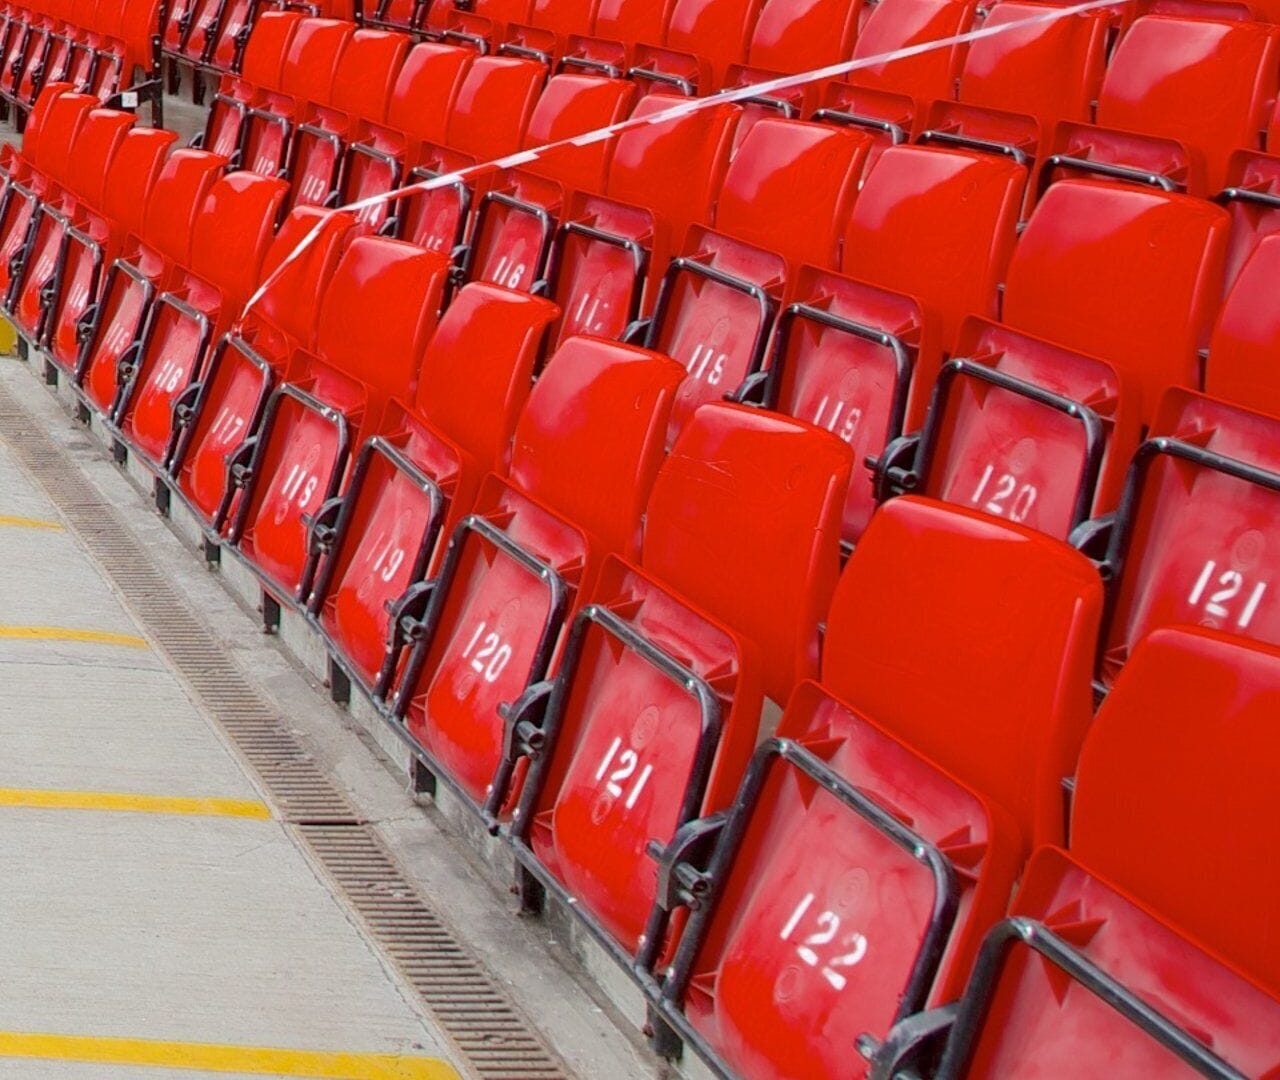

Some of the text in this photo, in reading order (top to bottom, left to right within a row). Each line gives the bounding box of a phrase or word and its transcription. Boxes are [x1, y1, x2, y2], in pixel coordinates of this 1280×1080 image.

[302, 174, 327, 202] 113
[492, 255, 525, 289] 116
[106, 320, 131, 354] 115
[154, 360, 184, 394] 116
[211, 407, 244, 446] 117
[971, 463, 1039, 525] 120
[1187, 559, 1267, 629] 121
[461, 622, 512, 683] 120
[595, 736, 654, 810] 121
[779, 892, 869, 991] 122
